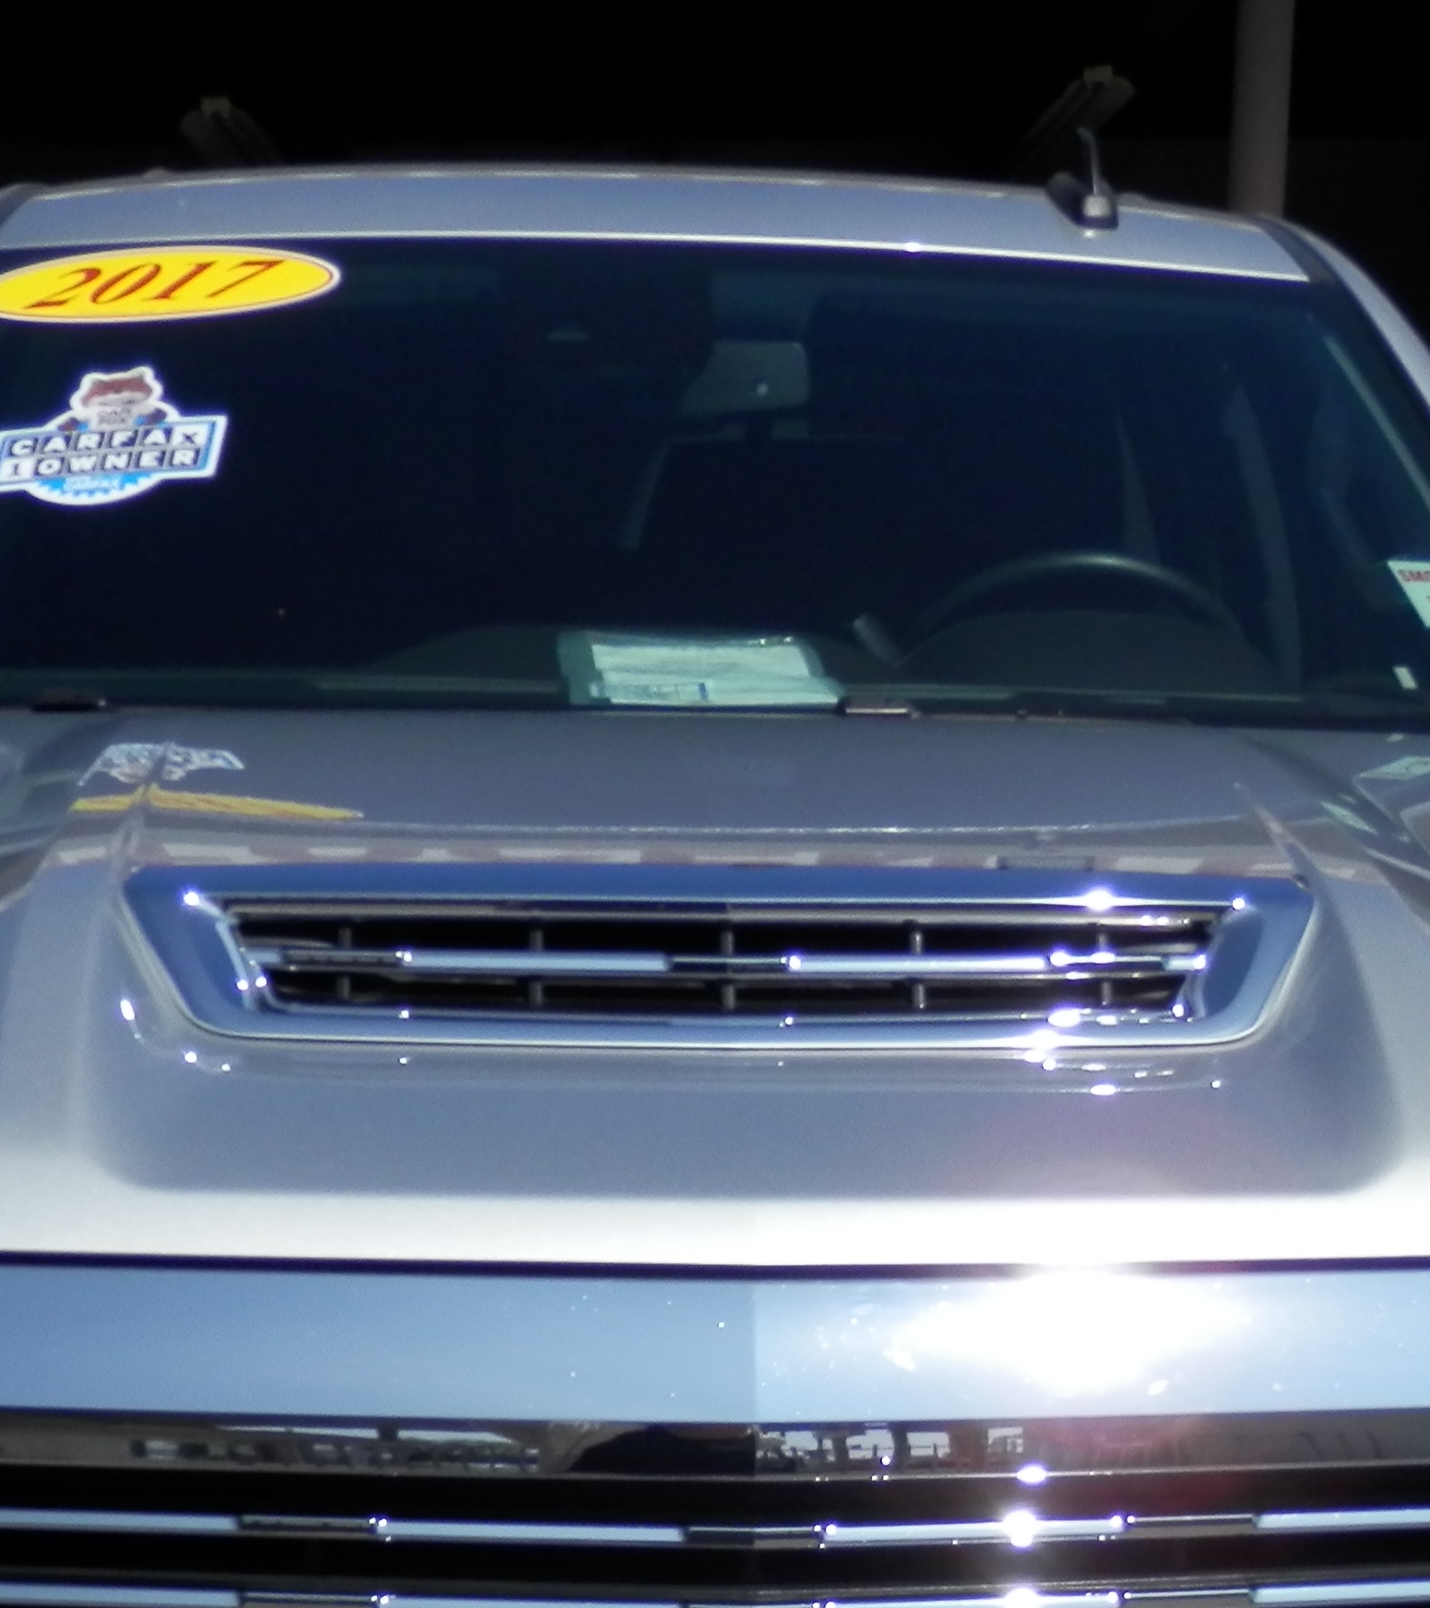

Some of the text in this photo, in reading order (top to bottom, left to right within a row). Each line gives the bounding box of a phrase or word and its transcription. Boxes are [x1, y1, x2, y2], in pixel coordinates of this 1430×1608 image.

[23, 259, 285, 310] 2017
[9, 430, 200, 457] CARFAX
[37, 449, 199, 475] OWNER
